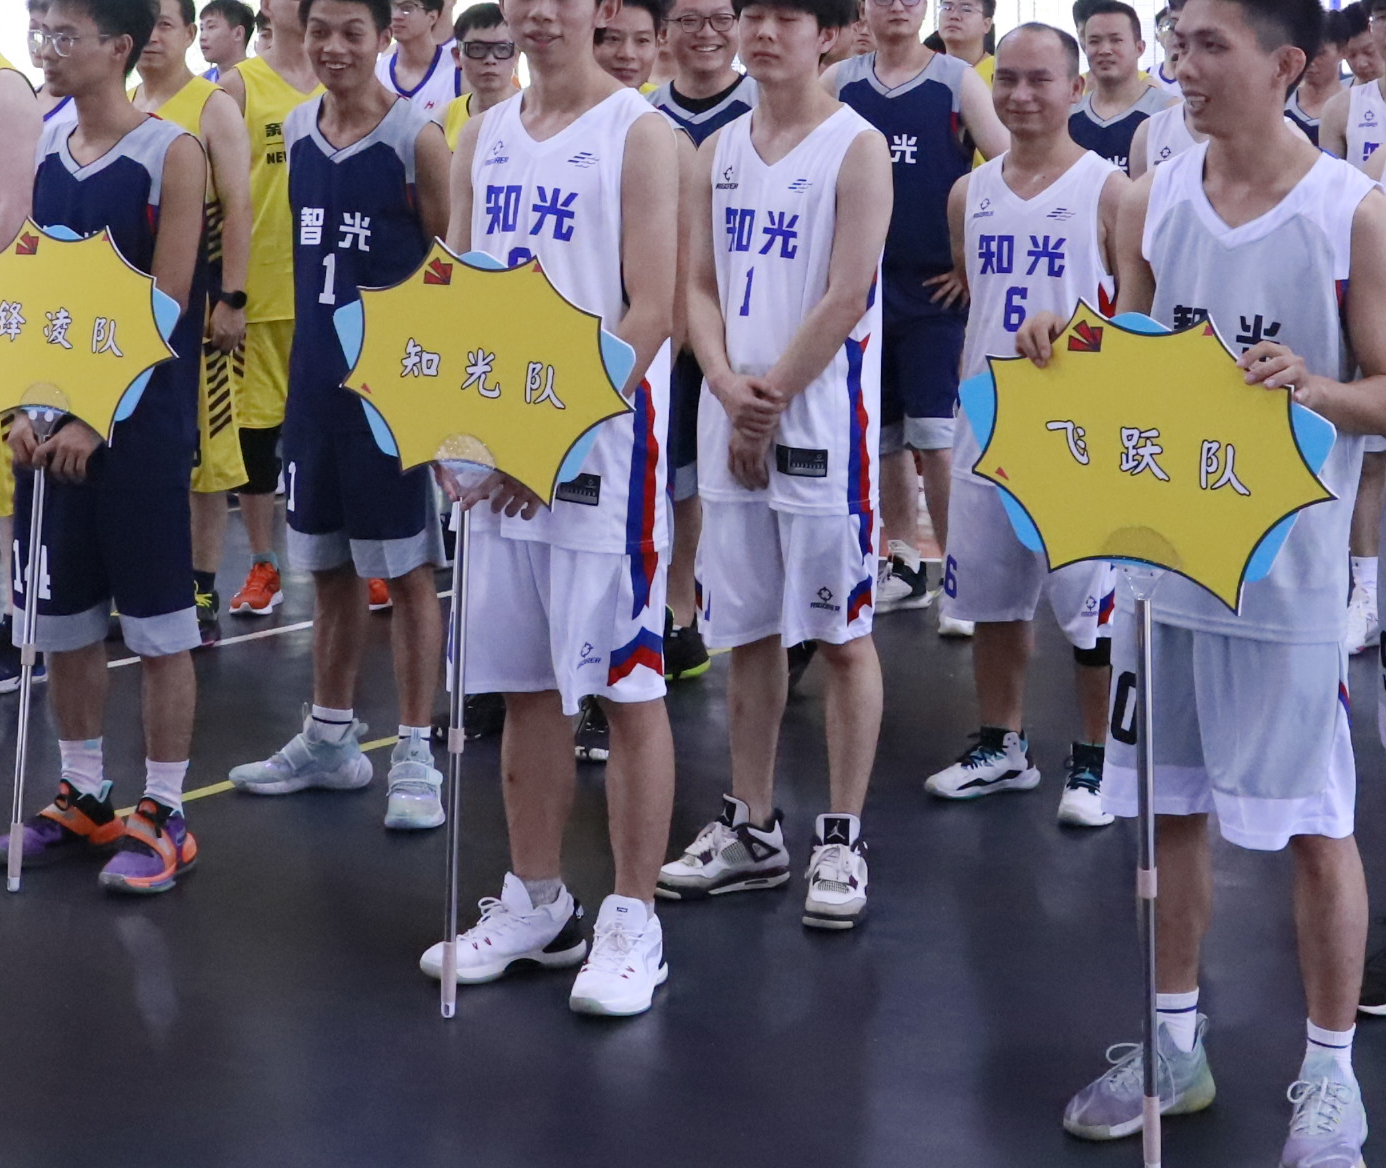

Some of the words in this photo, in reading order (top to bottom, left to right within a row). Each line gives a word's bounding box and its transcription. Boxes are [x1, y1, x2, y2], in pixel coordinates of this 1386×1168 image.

[300, 206, 372, 252] 智光
[486, 184, 579, 242] 知光
[725, 207, 799, 259] 知光
[318, 253, 335, 306] 1
[978, 234, 1067, 278] 知光
[739, 266, 754, 317] 1
[1003, 286, 1028, 332] 6
[400, 337, 566, 411] 知光队
[1045, 419, 1252, 497] 飞跃队
